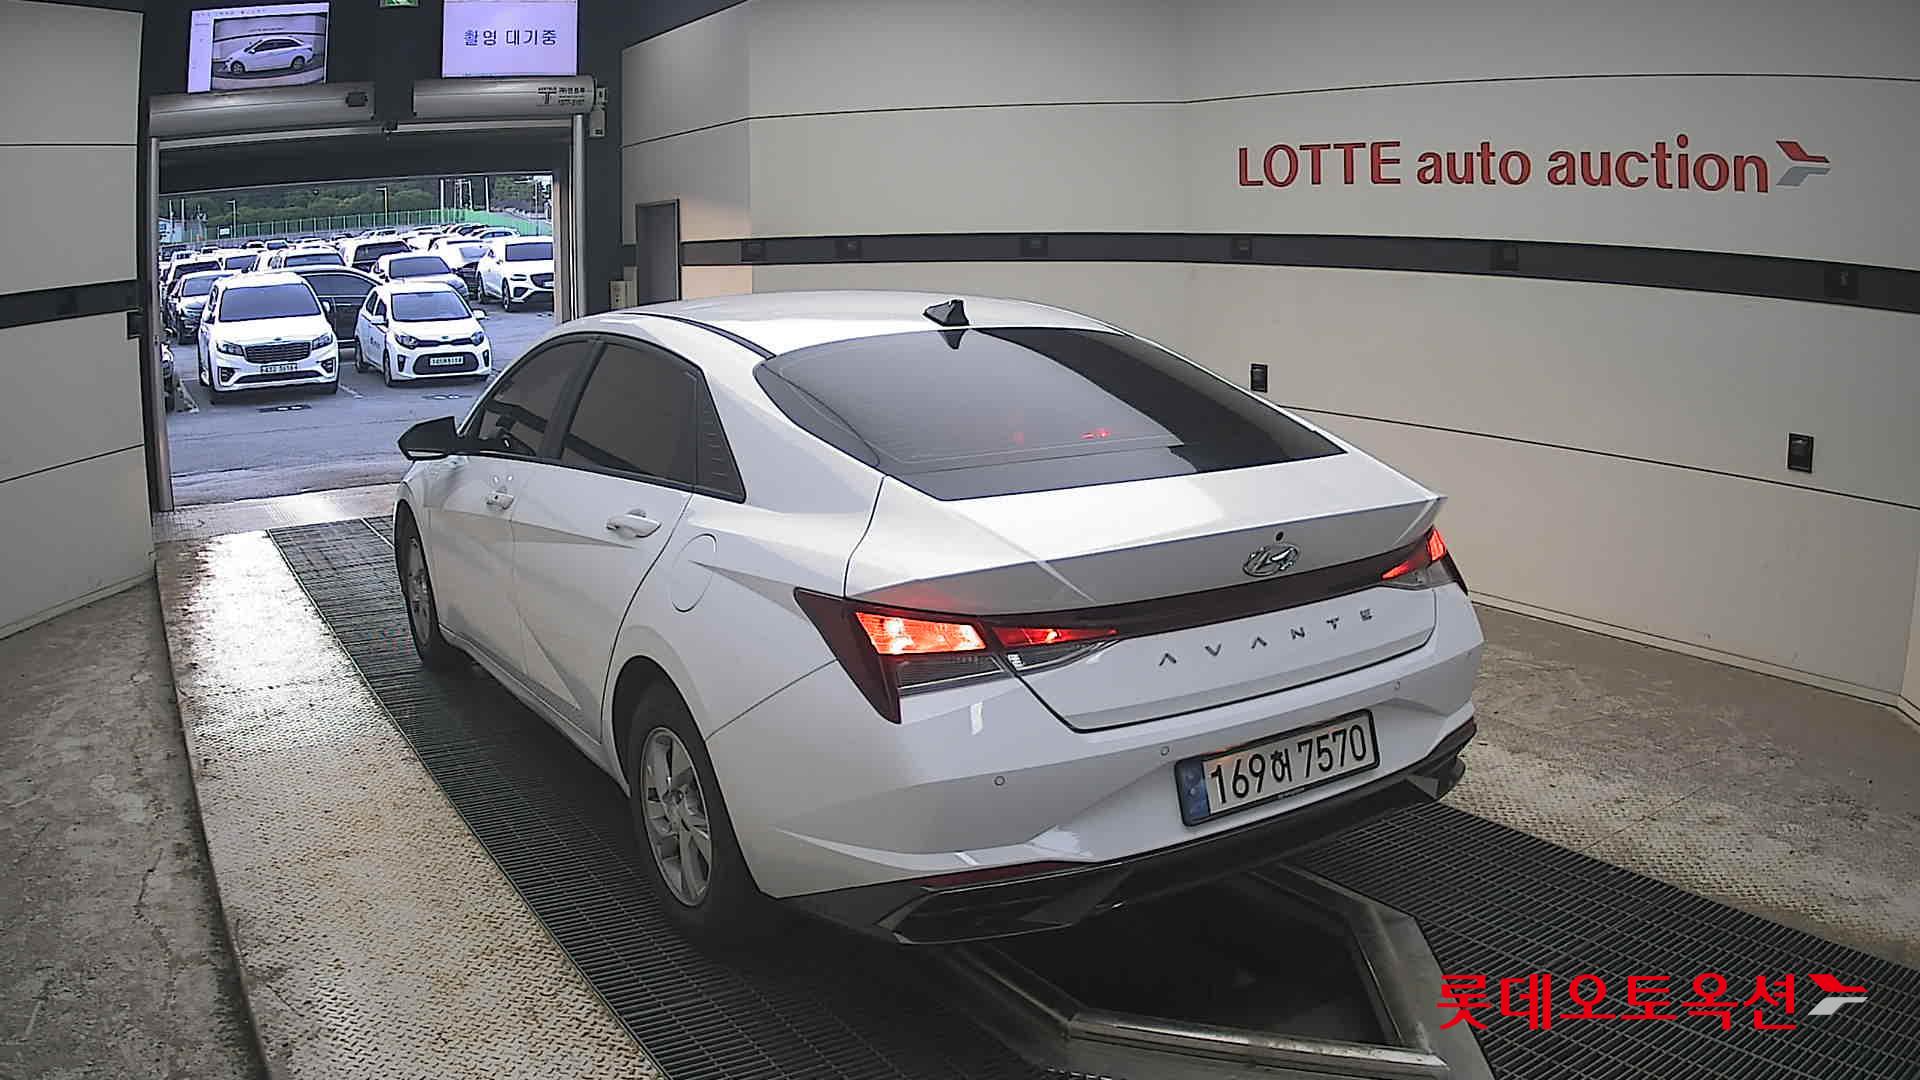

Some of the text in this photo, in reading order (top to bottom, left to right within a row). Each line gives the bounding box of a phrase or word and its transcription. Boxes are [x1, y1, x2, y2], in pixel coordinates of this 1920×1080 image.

[505, 29, 557, 46] 대기중
[1238, 134, 1769, 194] LOTTE auto auction
[1159, 608, 1373, 667] AVANTE
[1210, 724, 1366, 804] 169허 7570
